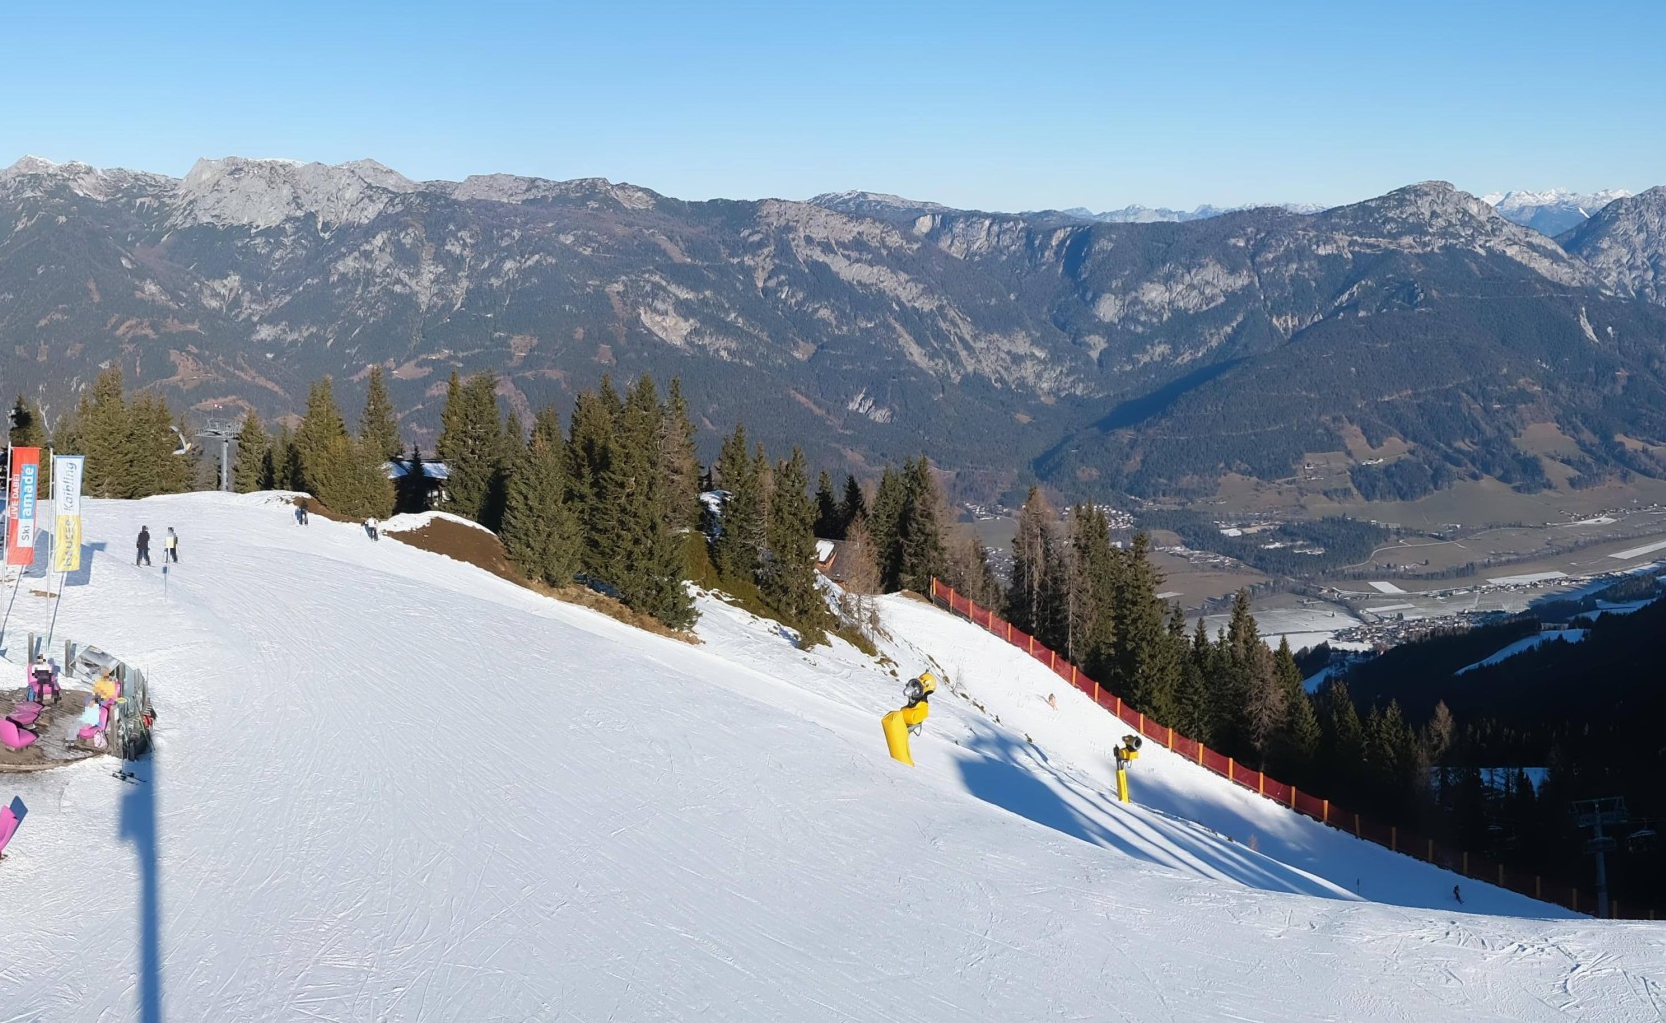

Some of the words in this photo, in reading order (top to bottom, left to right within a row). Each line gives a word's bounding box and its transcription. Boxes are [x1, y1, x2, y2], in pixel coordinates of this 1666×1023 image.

[12, 473, 21, 499] DABEI
[63, 462, 77, 512] Kaibling
[10, 500, 19, 520] LIVE
[21, 525, 30, 541] Ski
